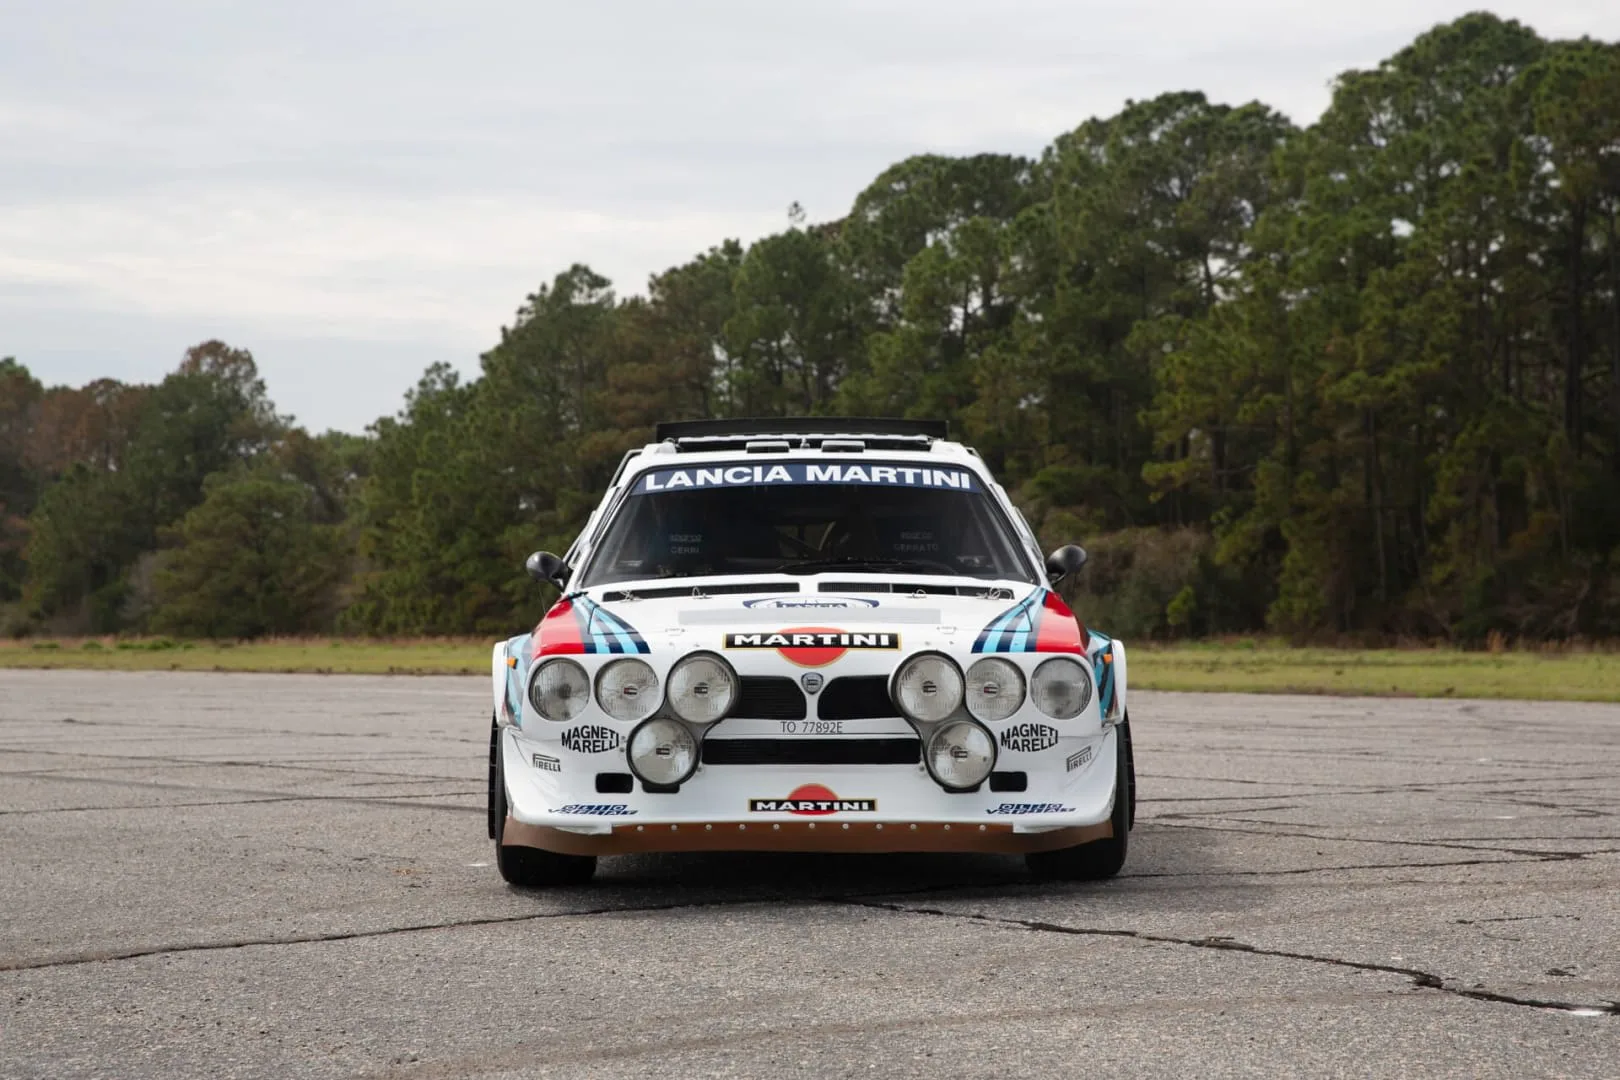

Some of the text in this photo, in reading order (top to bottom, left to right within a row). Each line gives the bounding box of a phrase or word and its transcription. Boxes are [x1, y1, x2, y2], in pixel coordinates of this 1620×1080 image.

[645, 465, 970, 490] LANCIA MARTINI
[734, 634, 889, 646] MARTINI
[561, 725, 620, 743] MAGNETI
[780, 721, 844, 733] TO 77892E
[1001, 723, 1058, 741] MAGNETI
[561, 736, 620, 754] MARELLI
[1001, 735, 1058, 752] MARELLI
[533, 753, 561, 772] PIRELLI
[1066, 746, 1092, 772] PIRELLI
[757, 802, 869, 811] MARTINI
